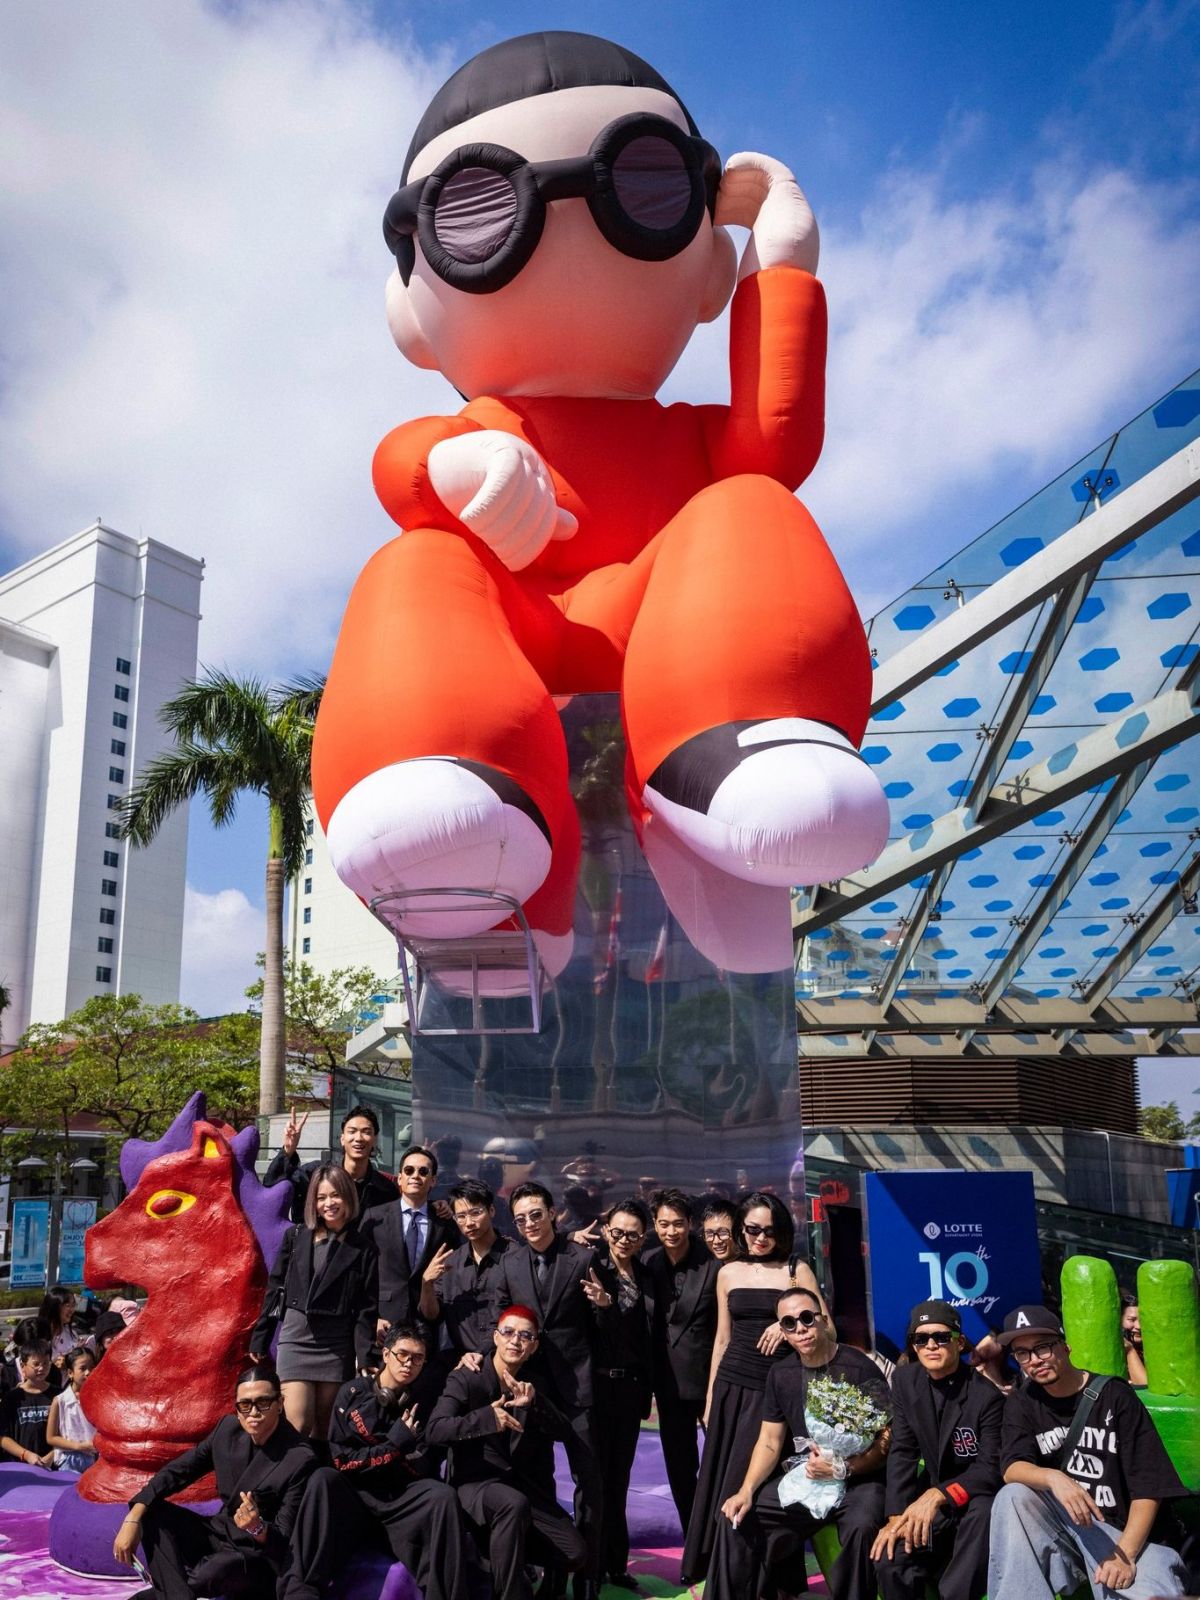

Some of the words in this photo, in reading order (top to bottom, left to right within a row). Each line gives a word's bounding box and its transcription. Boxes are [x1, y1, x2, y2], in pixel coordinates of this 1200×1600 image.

[944, 1224, 983, 1233] LOTTE
[1016, 1311, 1031, 1328] A
[1070, 1453, 1099, 1475] XXL
[1095, 1485, 1117, 1507] CO
